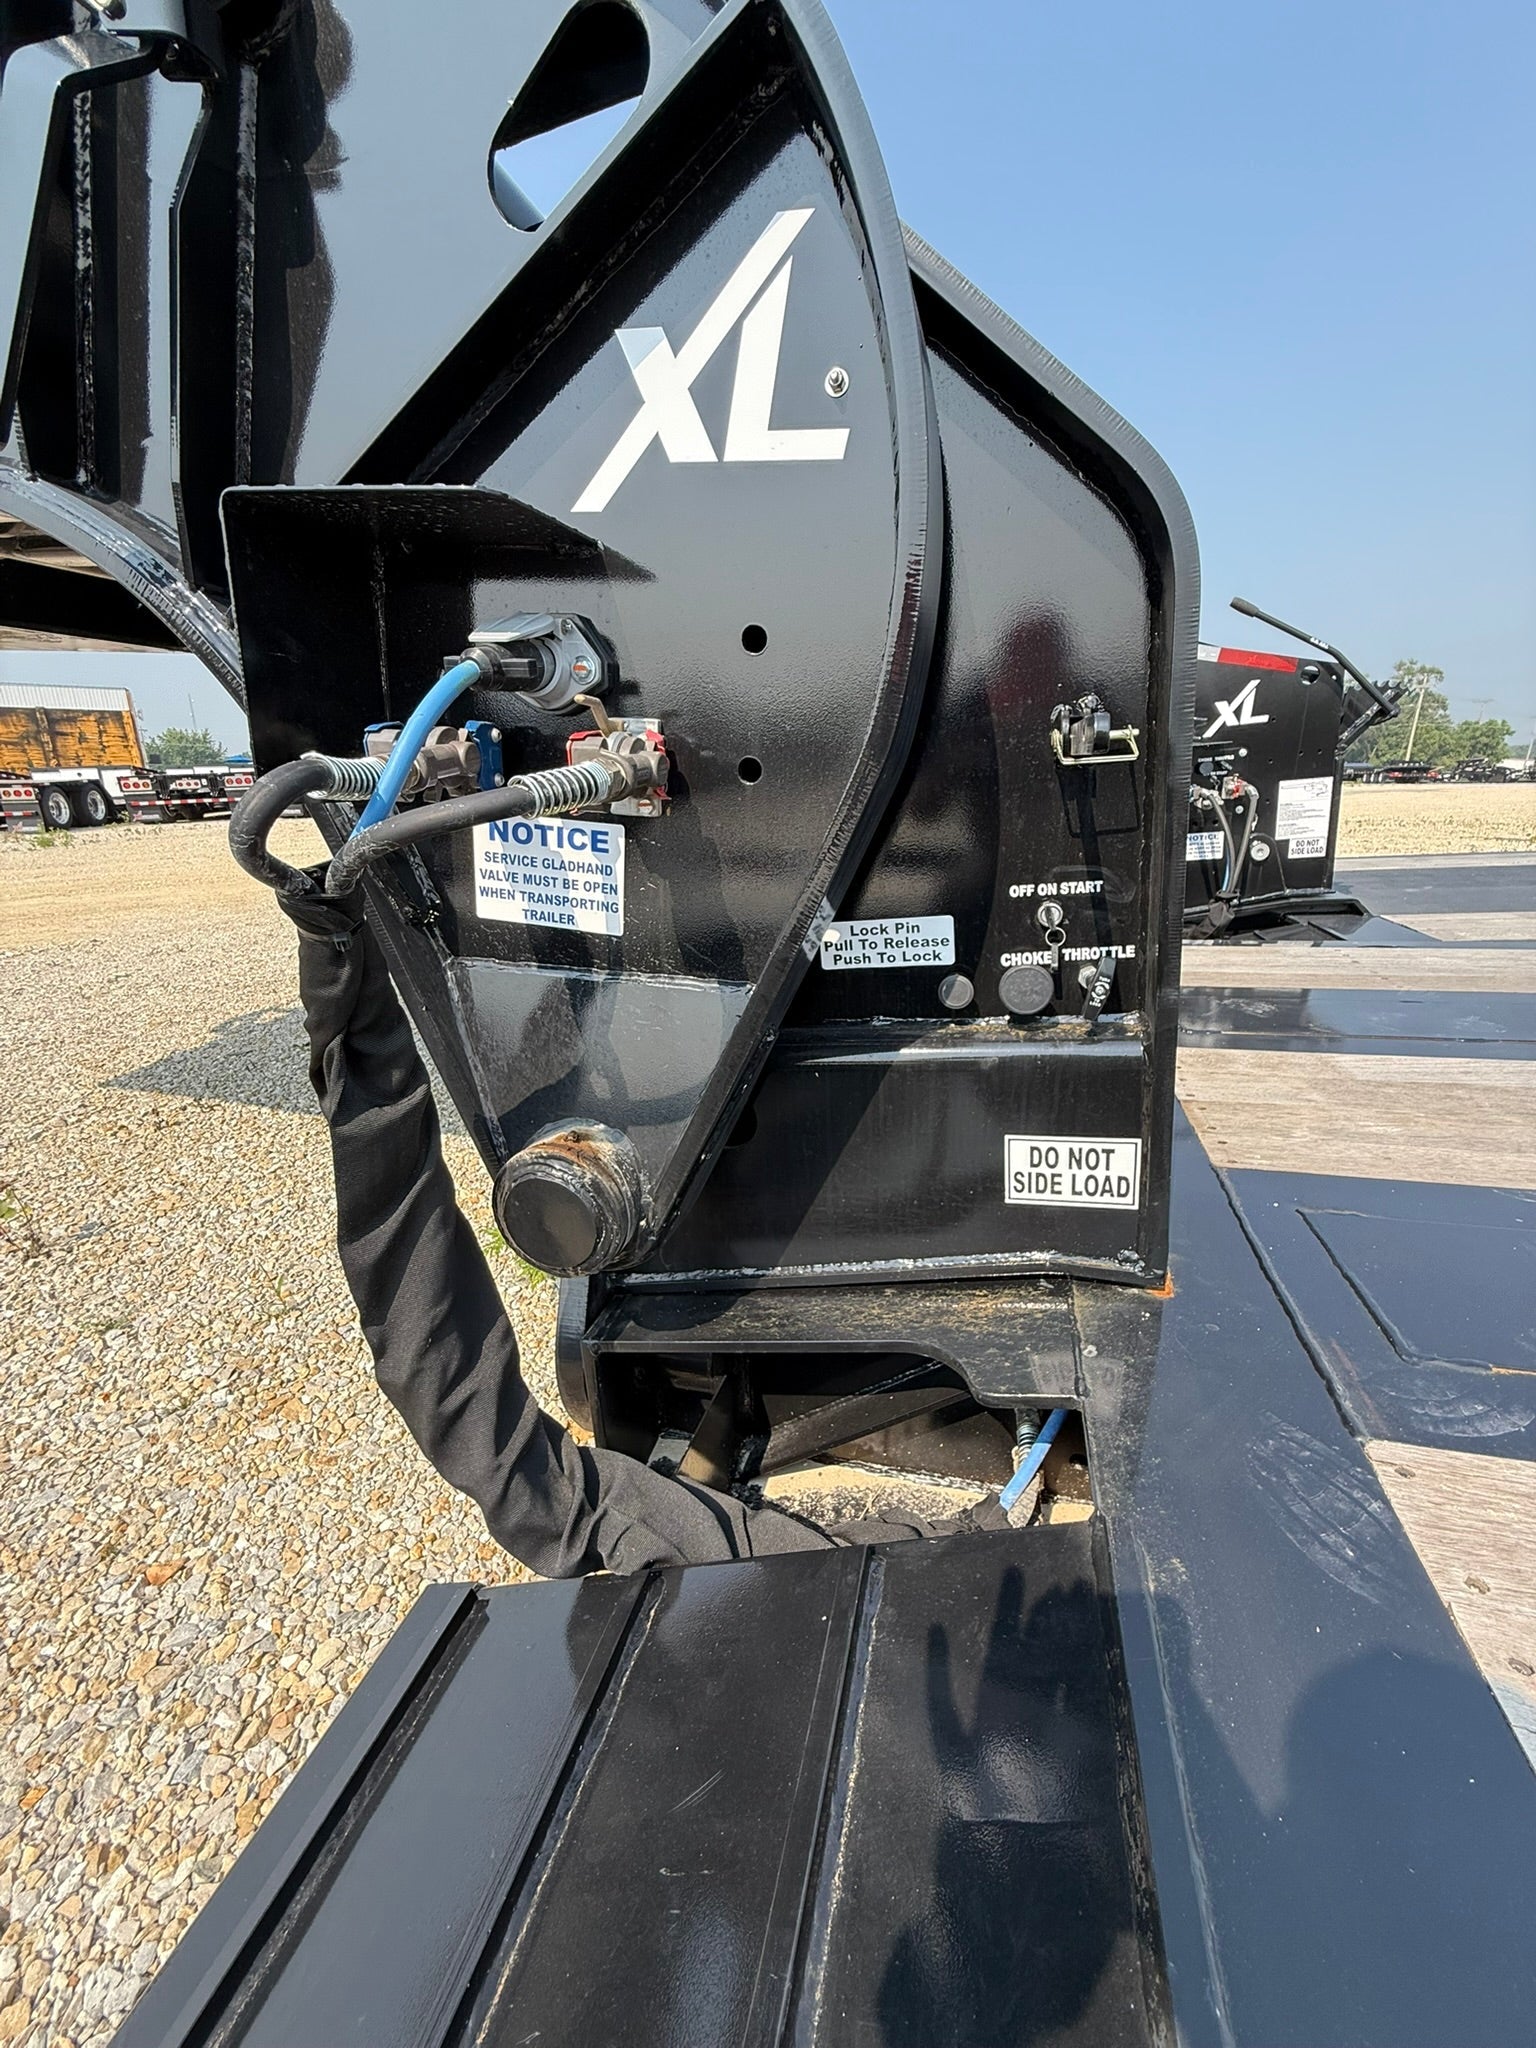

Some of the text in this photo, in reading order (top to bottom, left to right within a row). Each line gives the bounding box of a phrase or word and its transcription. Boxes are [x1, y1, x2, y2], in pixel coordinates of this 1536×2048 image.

[570, 207, 850, 513] XL
[1201, 679, 1270, 738] XL
[489, 820, 609, 854] NOTICE
[1306, 839, 1320, 847] NOT
[1306, 846, 1324, 855] LOAD
[484, 851, 613, 876] SERVICE GLADHAND
[480, 868, 618, 896] VALVE MUST BE OPEN
[1009, 880, 1104, 898] OFF ON START
[479, 886, 619, 914] WHEN TRANSPORTING
[522, 908, 575, 926] TRAILER
[850, 922, 920, 937] Lock Pin
[824, 936, 950, 952] Pull To Release
[833, 950, 942, 966] Push To Lock
[1000, 945, 1136, 967] CHOKE THROTTLE
[1030, 1146, 1115, 1171] DO NOT
[1013, 1171, 1130, 1198] SIDE LOAD
